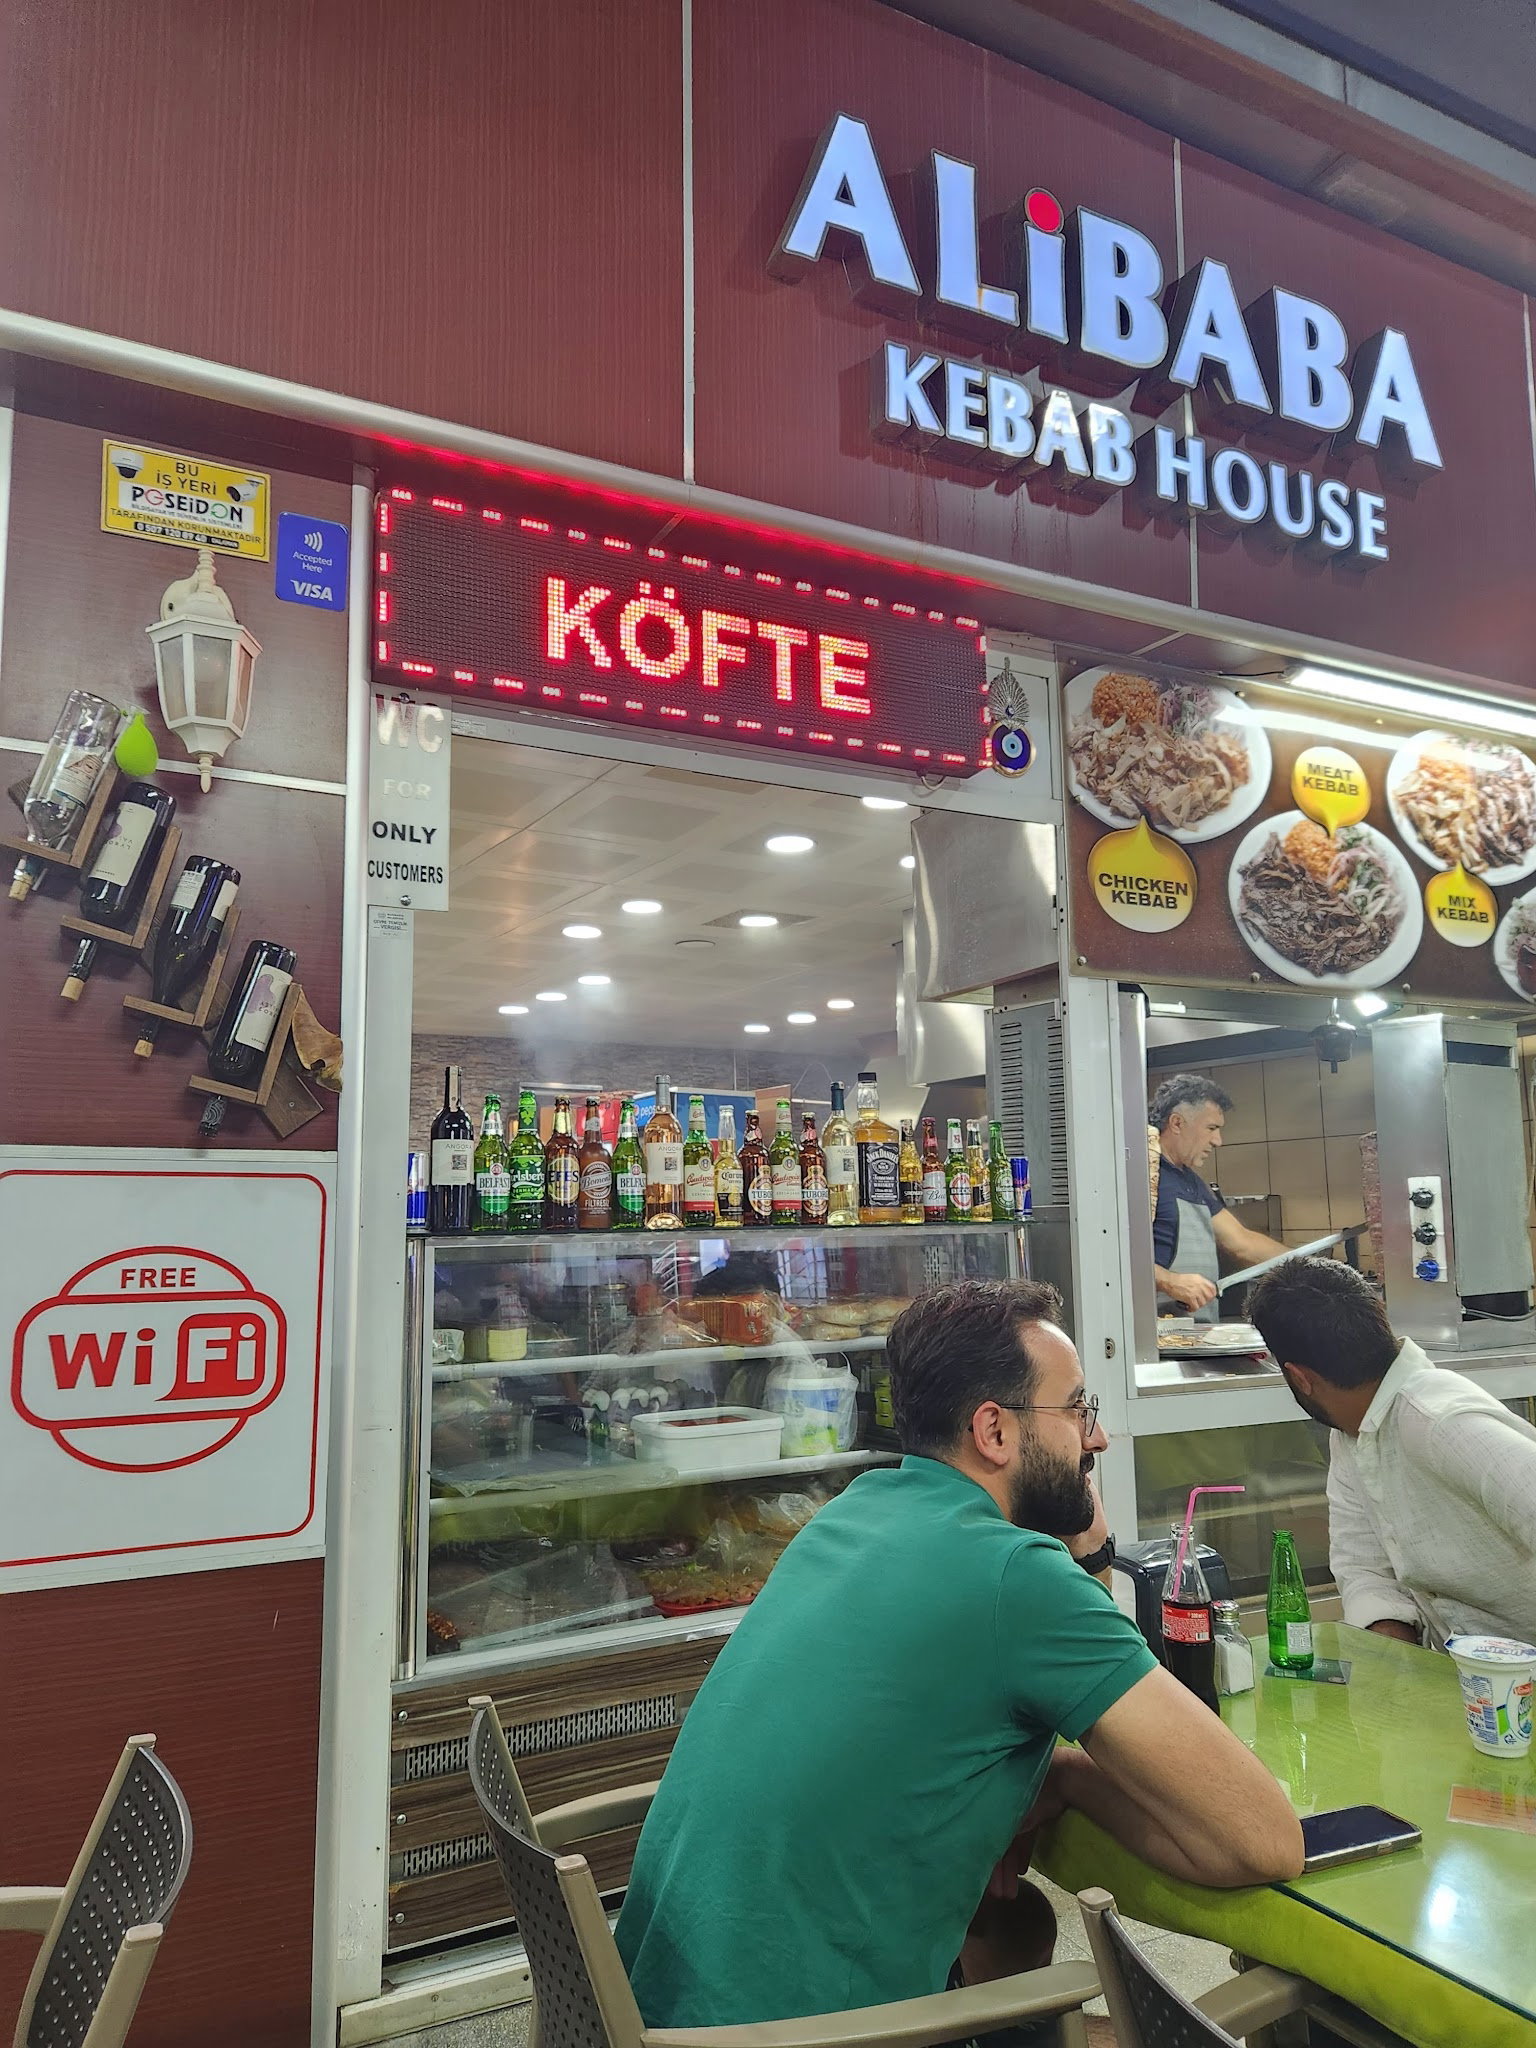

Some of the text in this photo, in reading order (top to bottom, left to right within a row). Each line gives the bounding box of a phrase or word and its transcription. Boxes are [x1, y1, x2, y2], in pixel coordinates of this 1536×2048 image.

[884, 340, 1389, 560] KEBAB HOUSE
[176, 462, 198, 476] BU
[157, 470, 216, 495] İŞ YERİ
[110, 507, 262, 545] TARAFINDAN KORUNMAKTADIR
[293, 551, 332, 566] Accepted
[302, 562, 322, 574] Here
[290, 580, 333, 601] VISA
[547, 576, 871, 715] KÖFTE
[375, 693, 444, 753] WC
[1307, 763, 1354, 781] MEAT
[383, 778, 431, 800] FOR
[1302, 775, 1360, 796] KEBAB
[372, 820, 437, 844] ONLY
[367, 860, 443, 884] CUSTOMERS
[1098, 872, 1188, 897] CHICKEN
[1111, 889, 1179, 910] KEBAB
[1448, 894, 1477, 910] MIX
[1437, 906, 1489, 924] KEBAB
[548, 1170, 579, 1183] EFES
[120, 1267, 196, 1289] FREE
